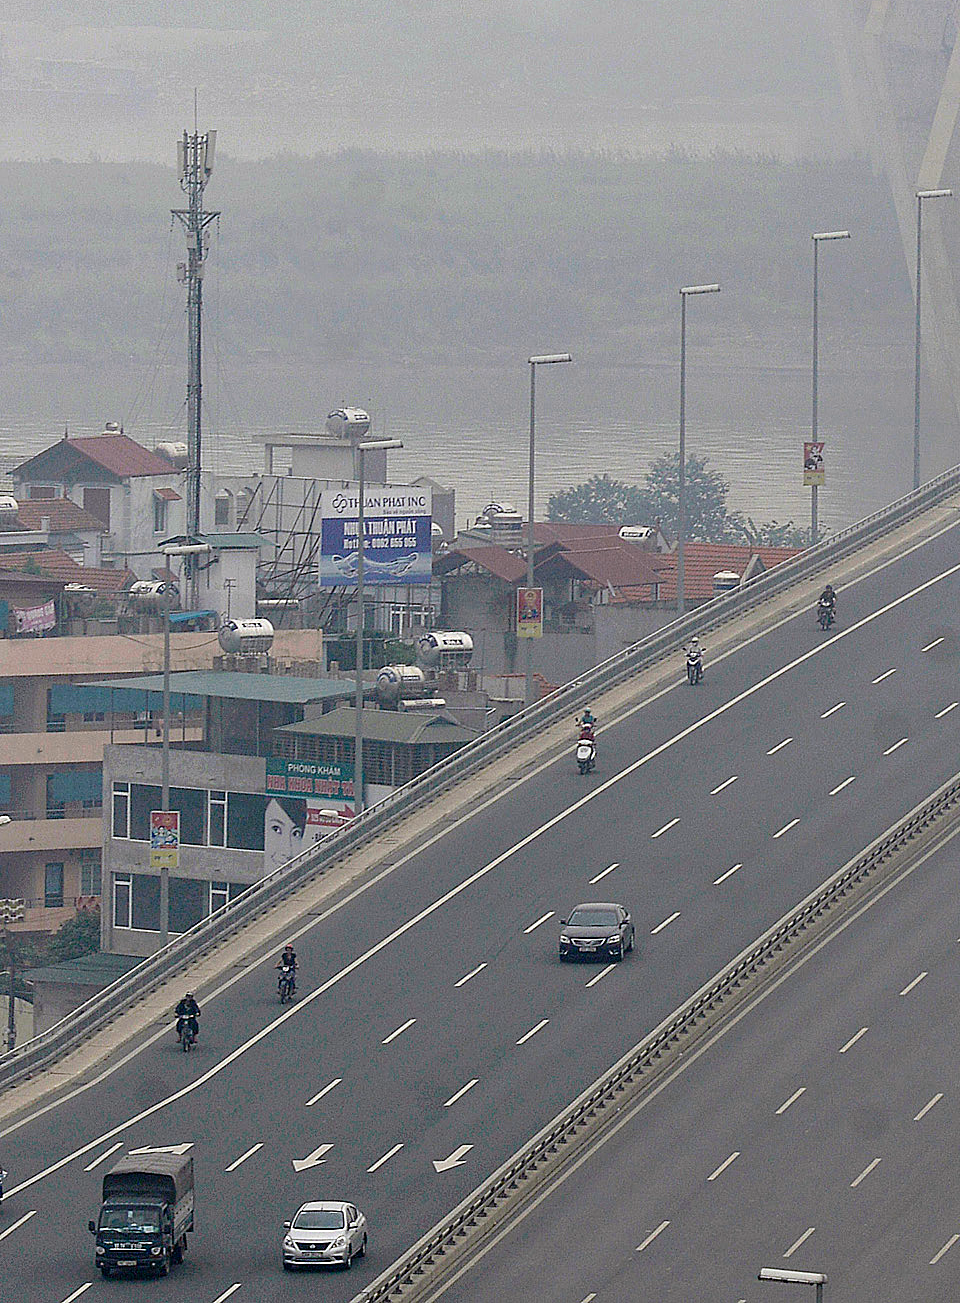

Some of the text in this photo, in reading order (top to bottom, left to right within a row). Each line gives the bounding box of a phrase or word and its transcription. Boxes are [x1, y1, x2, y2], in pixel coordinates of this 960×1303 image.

[408, 496, 426, 507] INC
[396, 518, 417, 534] PHÁT
[267, 774, 286, 790] NHA
[288, 776, 313, 793] KHOA
